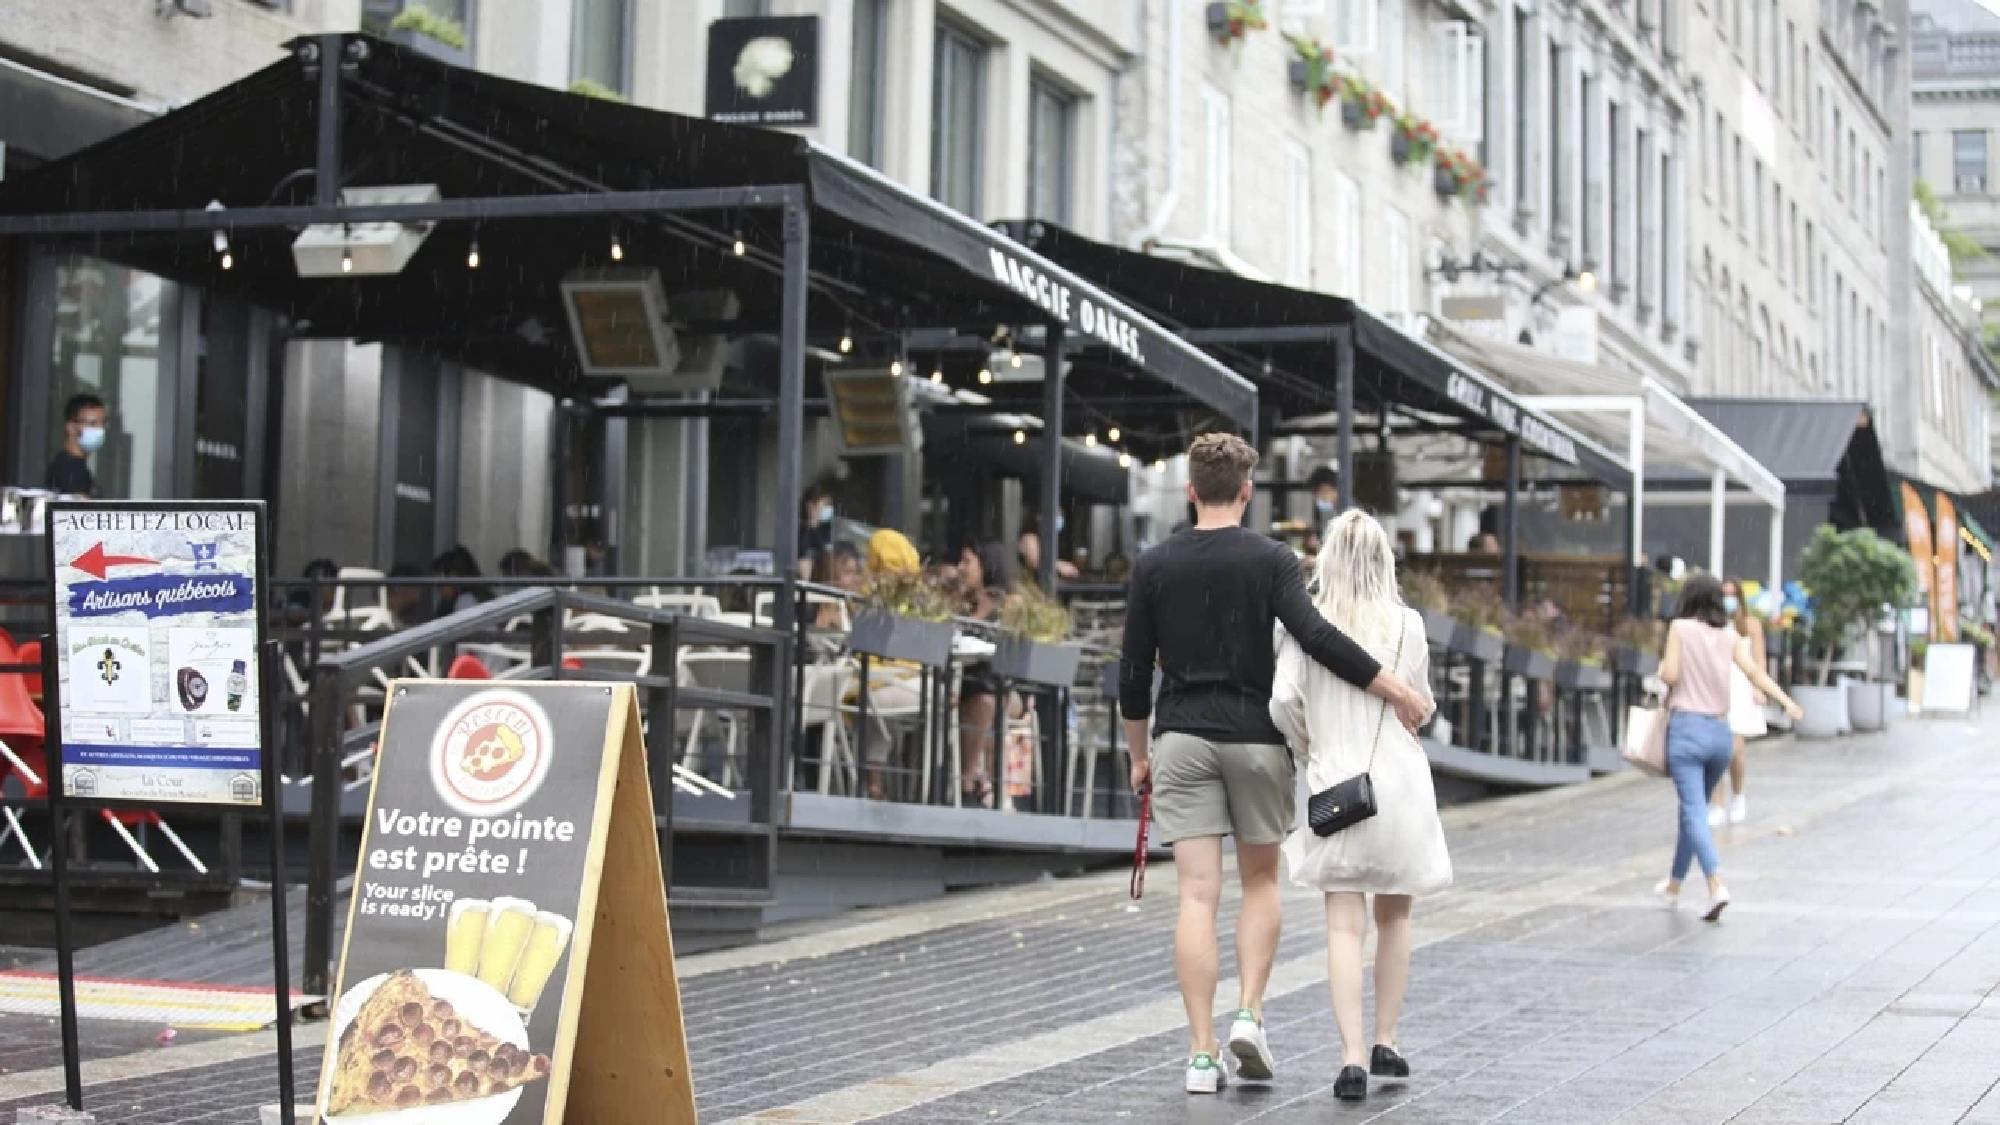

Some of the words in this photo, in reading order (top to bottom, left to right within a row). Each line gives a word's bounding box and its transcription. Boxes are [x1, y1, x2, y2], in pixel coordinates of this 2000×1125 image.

[989, 247, 1070, 322] MAGGIE
[66, 513, 167, 531] ACHETEZ
[174, 513, 249, 531] LOCAL
[82, 588, 152, 610] Artisans
[155, 578, 237, 609] québécois
[377, 808, 462, 837] Votre
[468, 812, 575, 845] pointe
[369, 846, 418, 870] est
[422, 845, 510, 878] prête
[516, 848, 528, 875] !
[365, 882, 409, 900] Your
[411, 884, 454, 902] slice
[361, 899, 376, 914] is
[380, 902, 436, 920] ready
[439, 903, 446, 918] !
